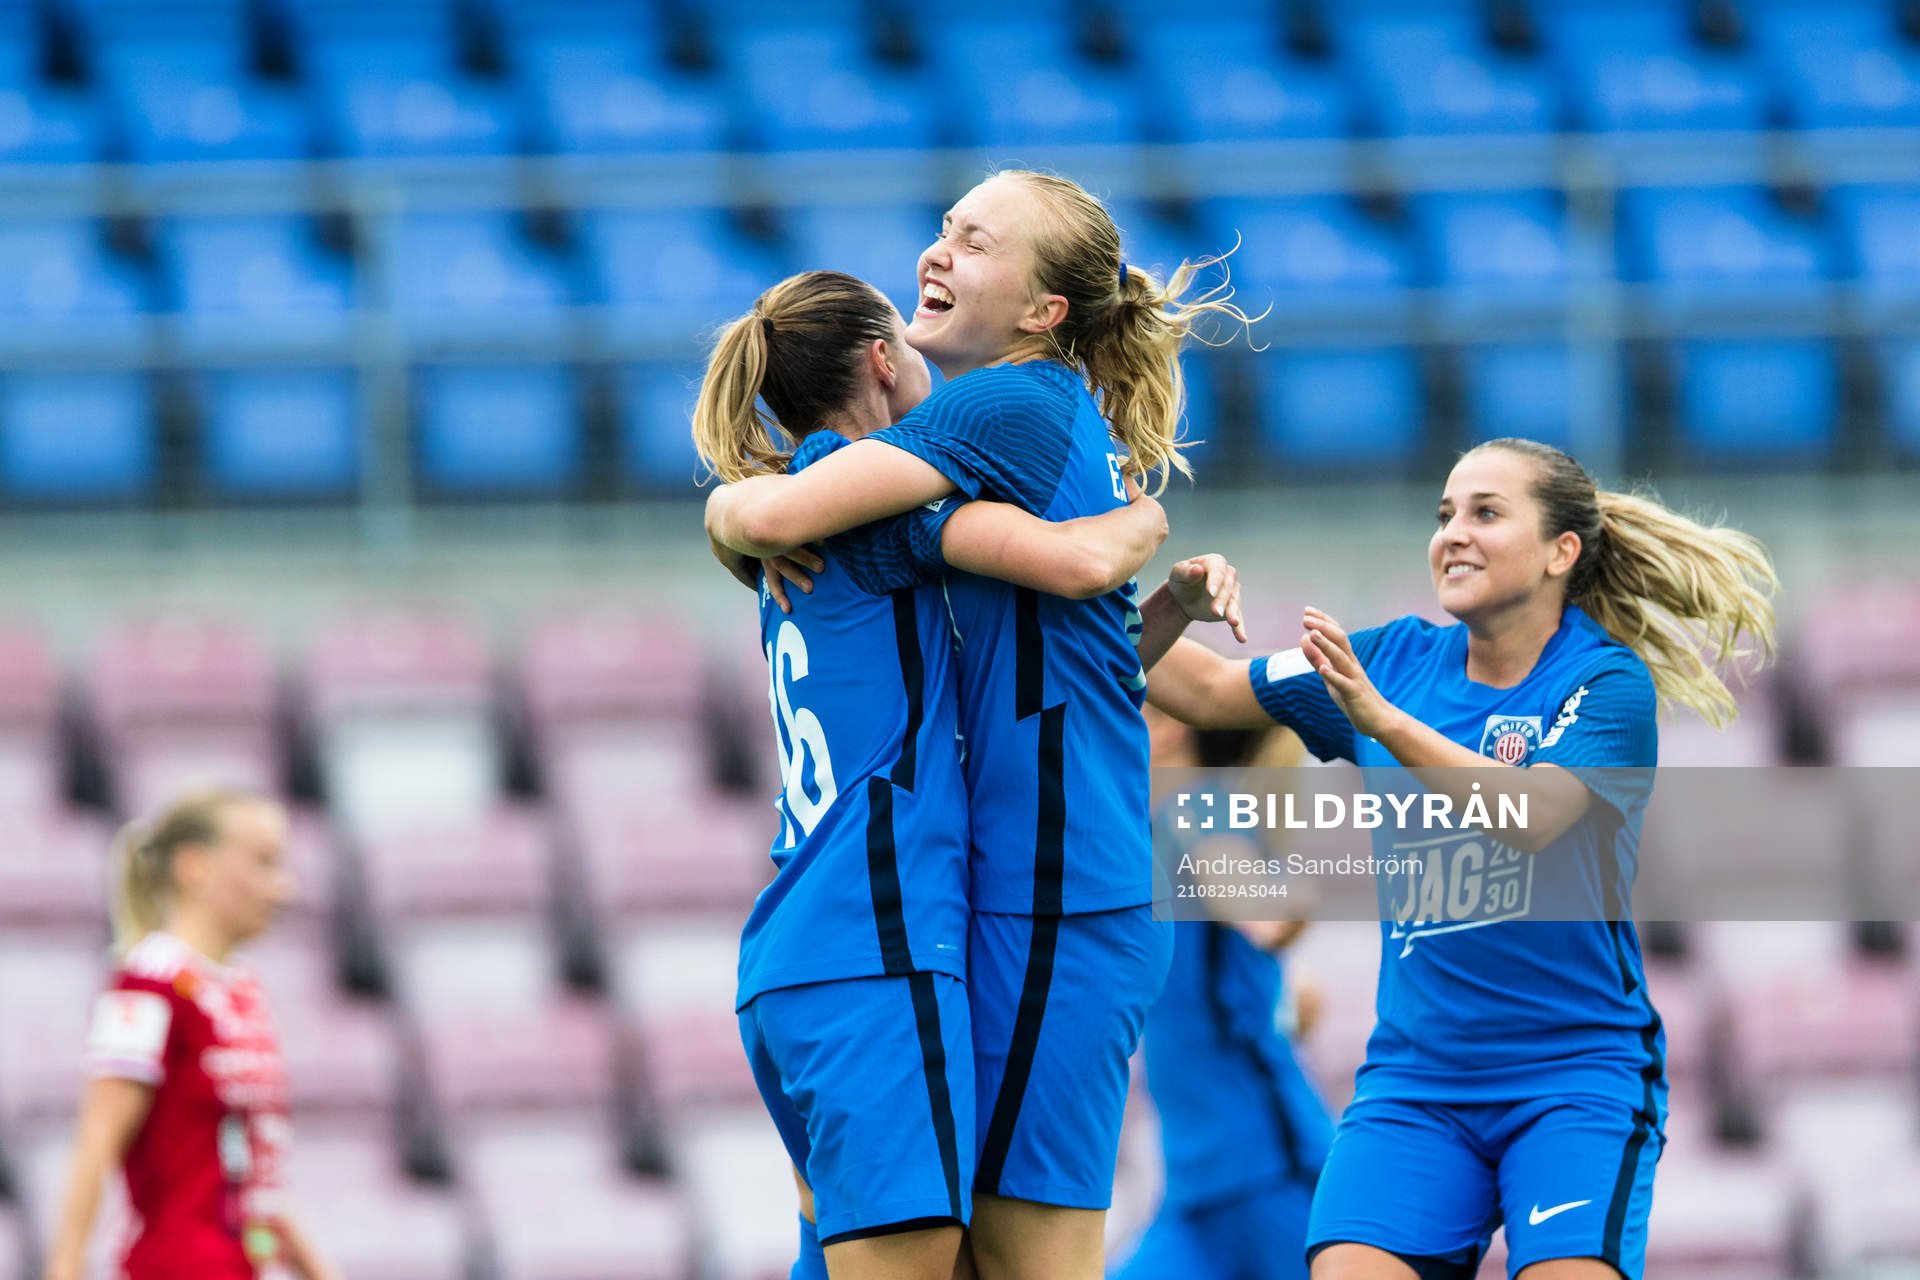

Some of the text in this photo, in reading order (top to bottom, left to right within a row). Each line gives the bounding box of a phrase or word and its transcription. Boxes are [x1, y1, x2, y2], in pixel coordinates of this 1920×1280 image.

[1492, 721, 1535, 738] UNITED
[1396, 842, 1484, 927] JAG
[1484, 878, 1519, 914] 30
